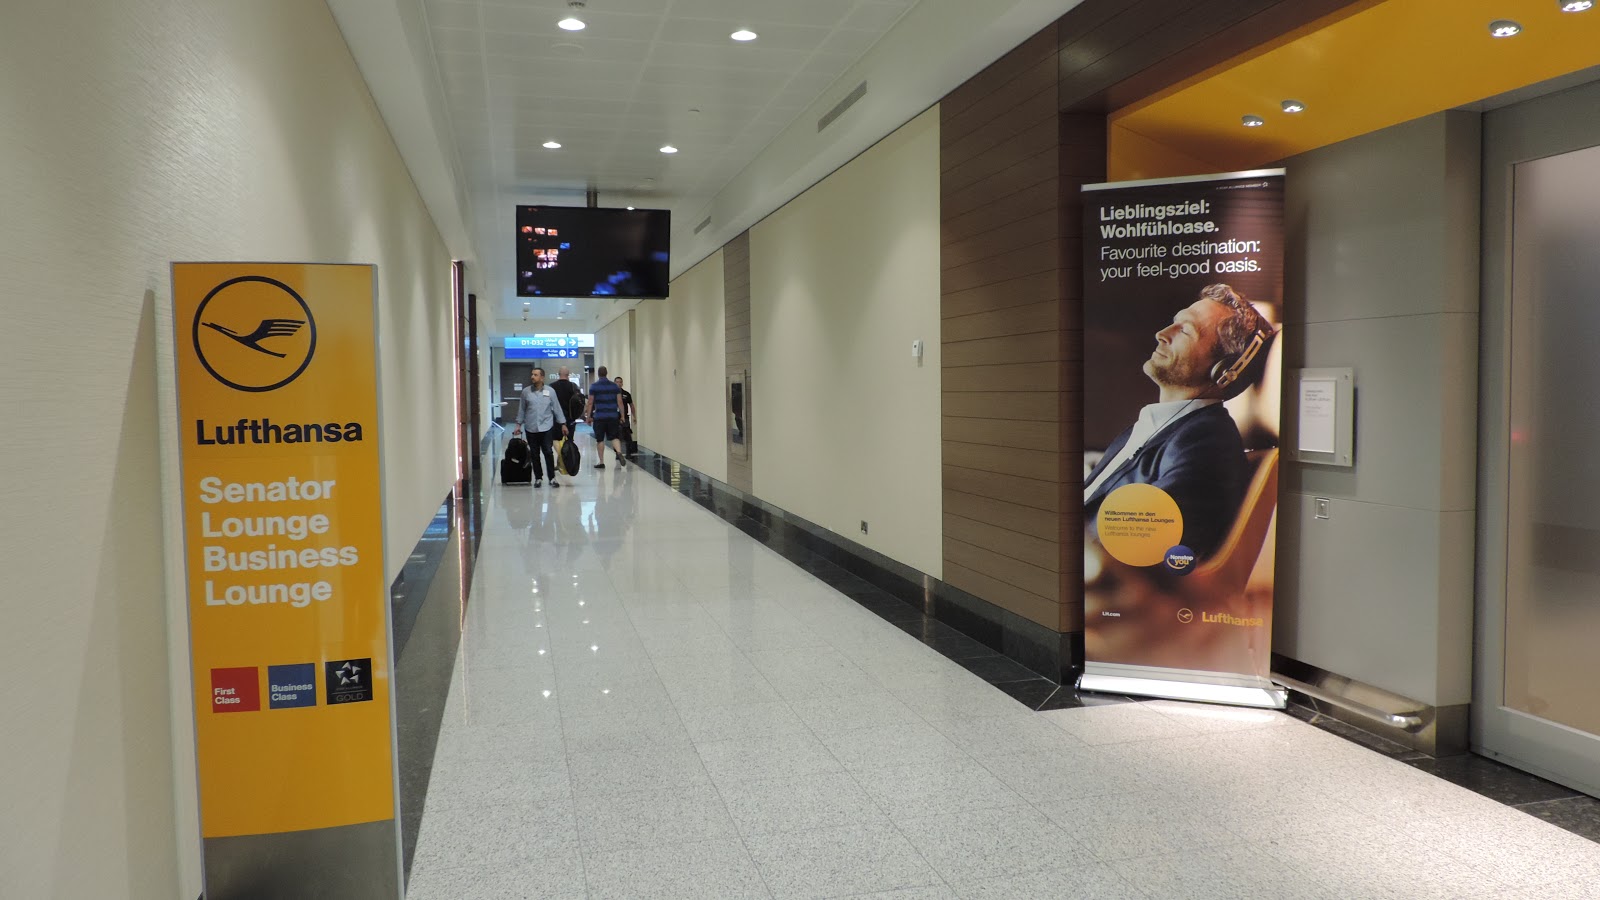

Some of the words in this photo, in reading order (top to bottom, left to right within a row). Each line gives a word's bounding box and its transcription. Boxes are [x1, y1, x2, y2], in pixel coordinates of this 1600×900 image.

[1100, 199, 1210, 221] Lieblingsziel:
[1100, 220, 1219, 239] Wohlfühloase.
[1101, 243, 1167, 261] Favourite
[1172, 238, 1261, 257] destination:
[1100, 265, 1132, 282] your
[1137, 259, 1210, 279] feel-good
[1215, 257, 1262, 273] oasis.
[196, 418, 363, 445] Lufthansa
[200, 476, 336, 504] Senator
[202, 511, 330, 540] Lounge
[204, 544, 359, 572] Business
[205, 580, 332, 608] Lounge
[1202, 611, 1264, 627] Lufthansa
[214, 687, 235, 696] First
[271, 683, 313, 692] Business
[272, 692, 297, 702] Class
[336, 692, 363, 702] GOLD
[214, 696, 240, 704] Class
